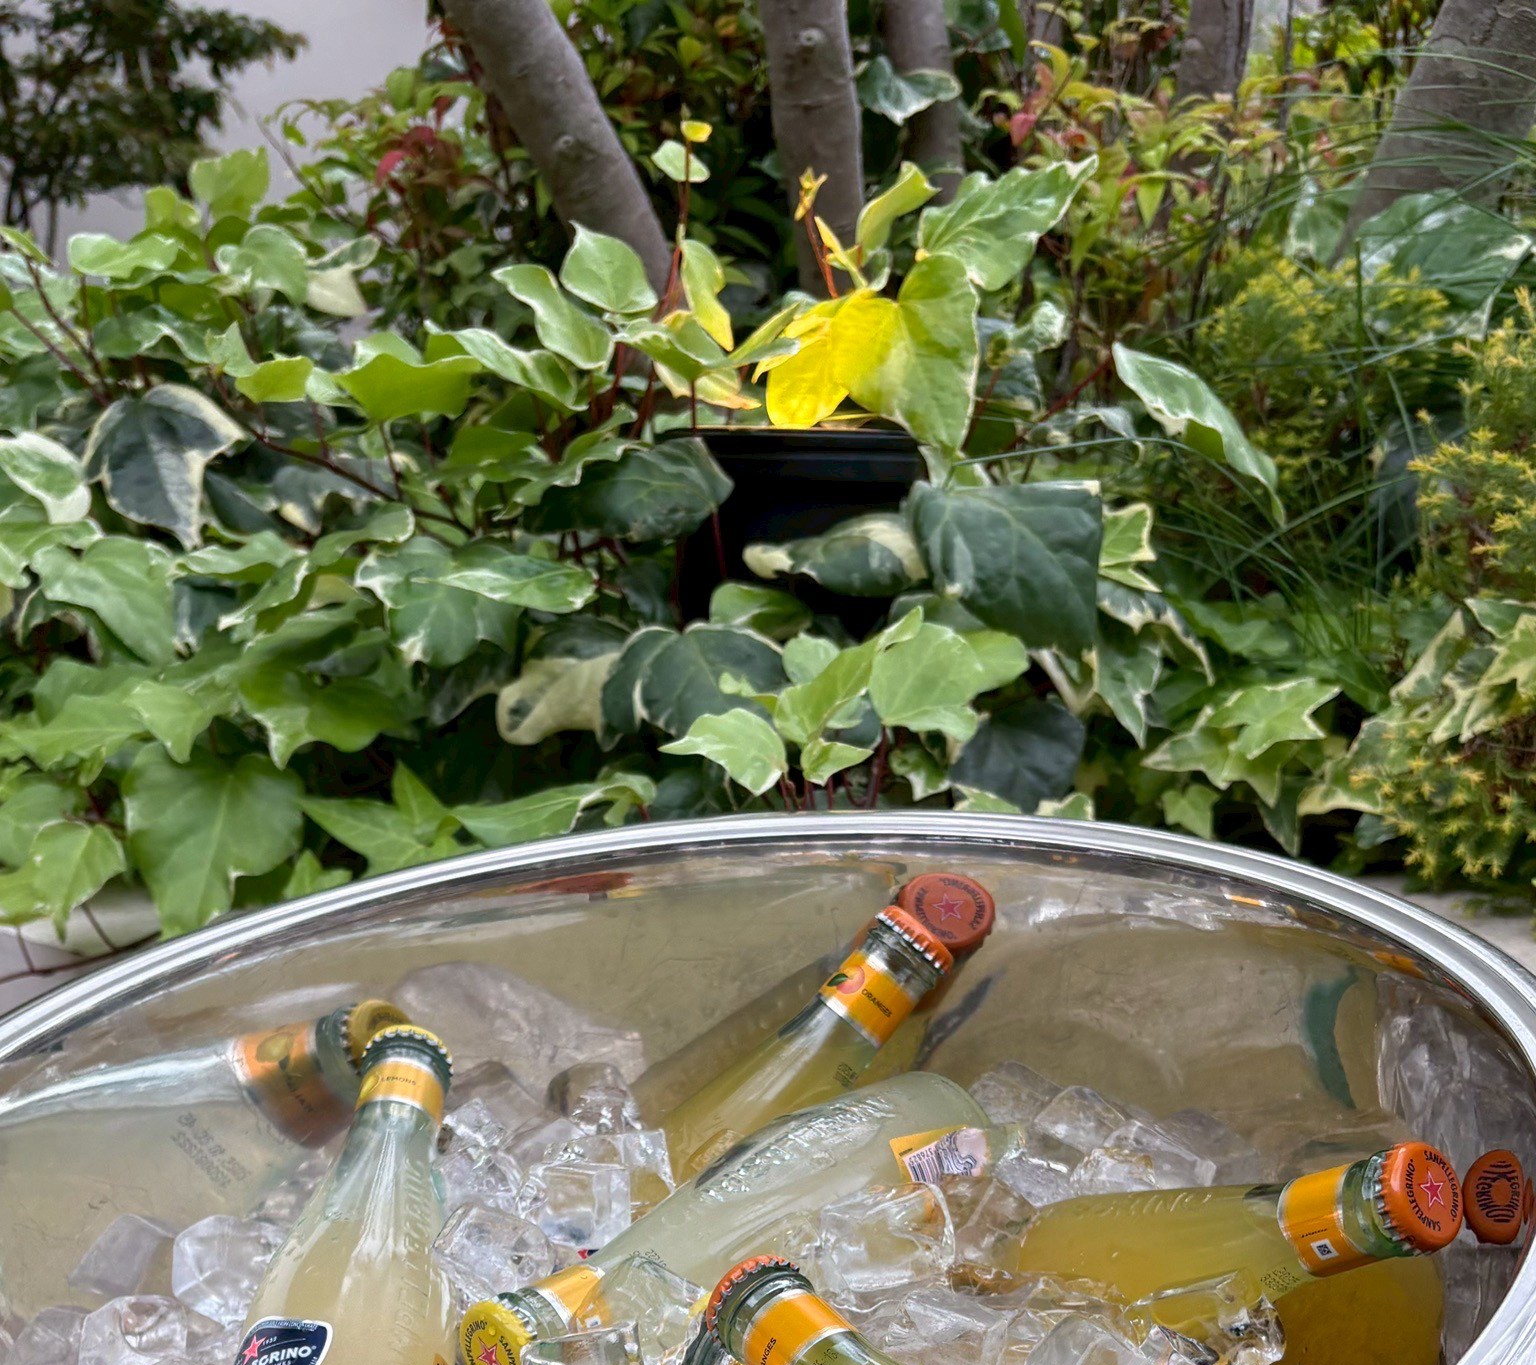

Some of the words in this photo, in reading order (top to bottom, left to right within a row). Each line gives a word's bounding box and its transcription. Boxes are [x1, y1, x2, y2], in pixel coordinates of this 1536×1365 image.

[861, 988, 893, 1018] ORANGES
[381, 1076, 416, 1086] LEMONS
[1405, 1159, 1442, 1232] SANPELLEGRINO
[1423, 1150, 1459, 1222] SANPELLEGRINO
